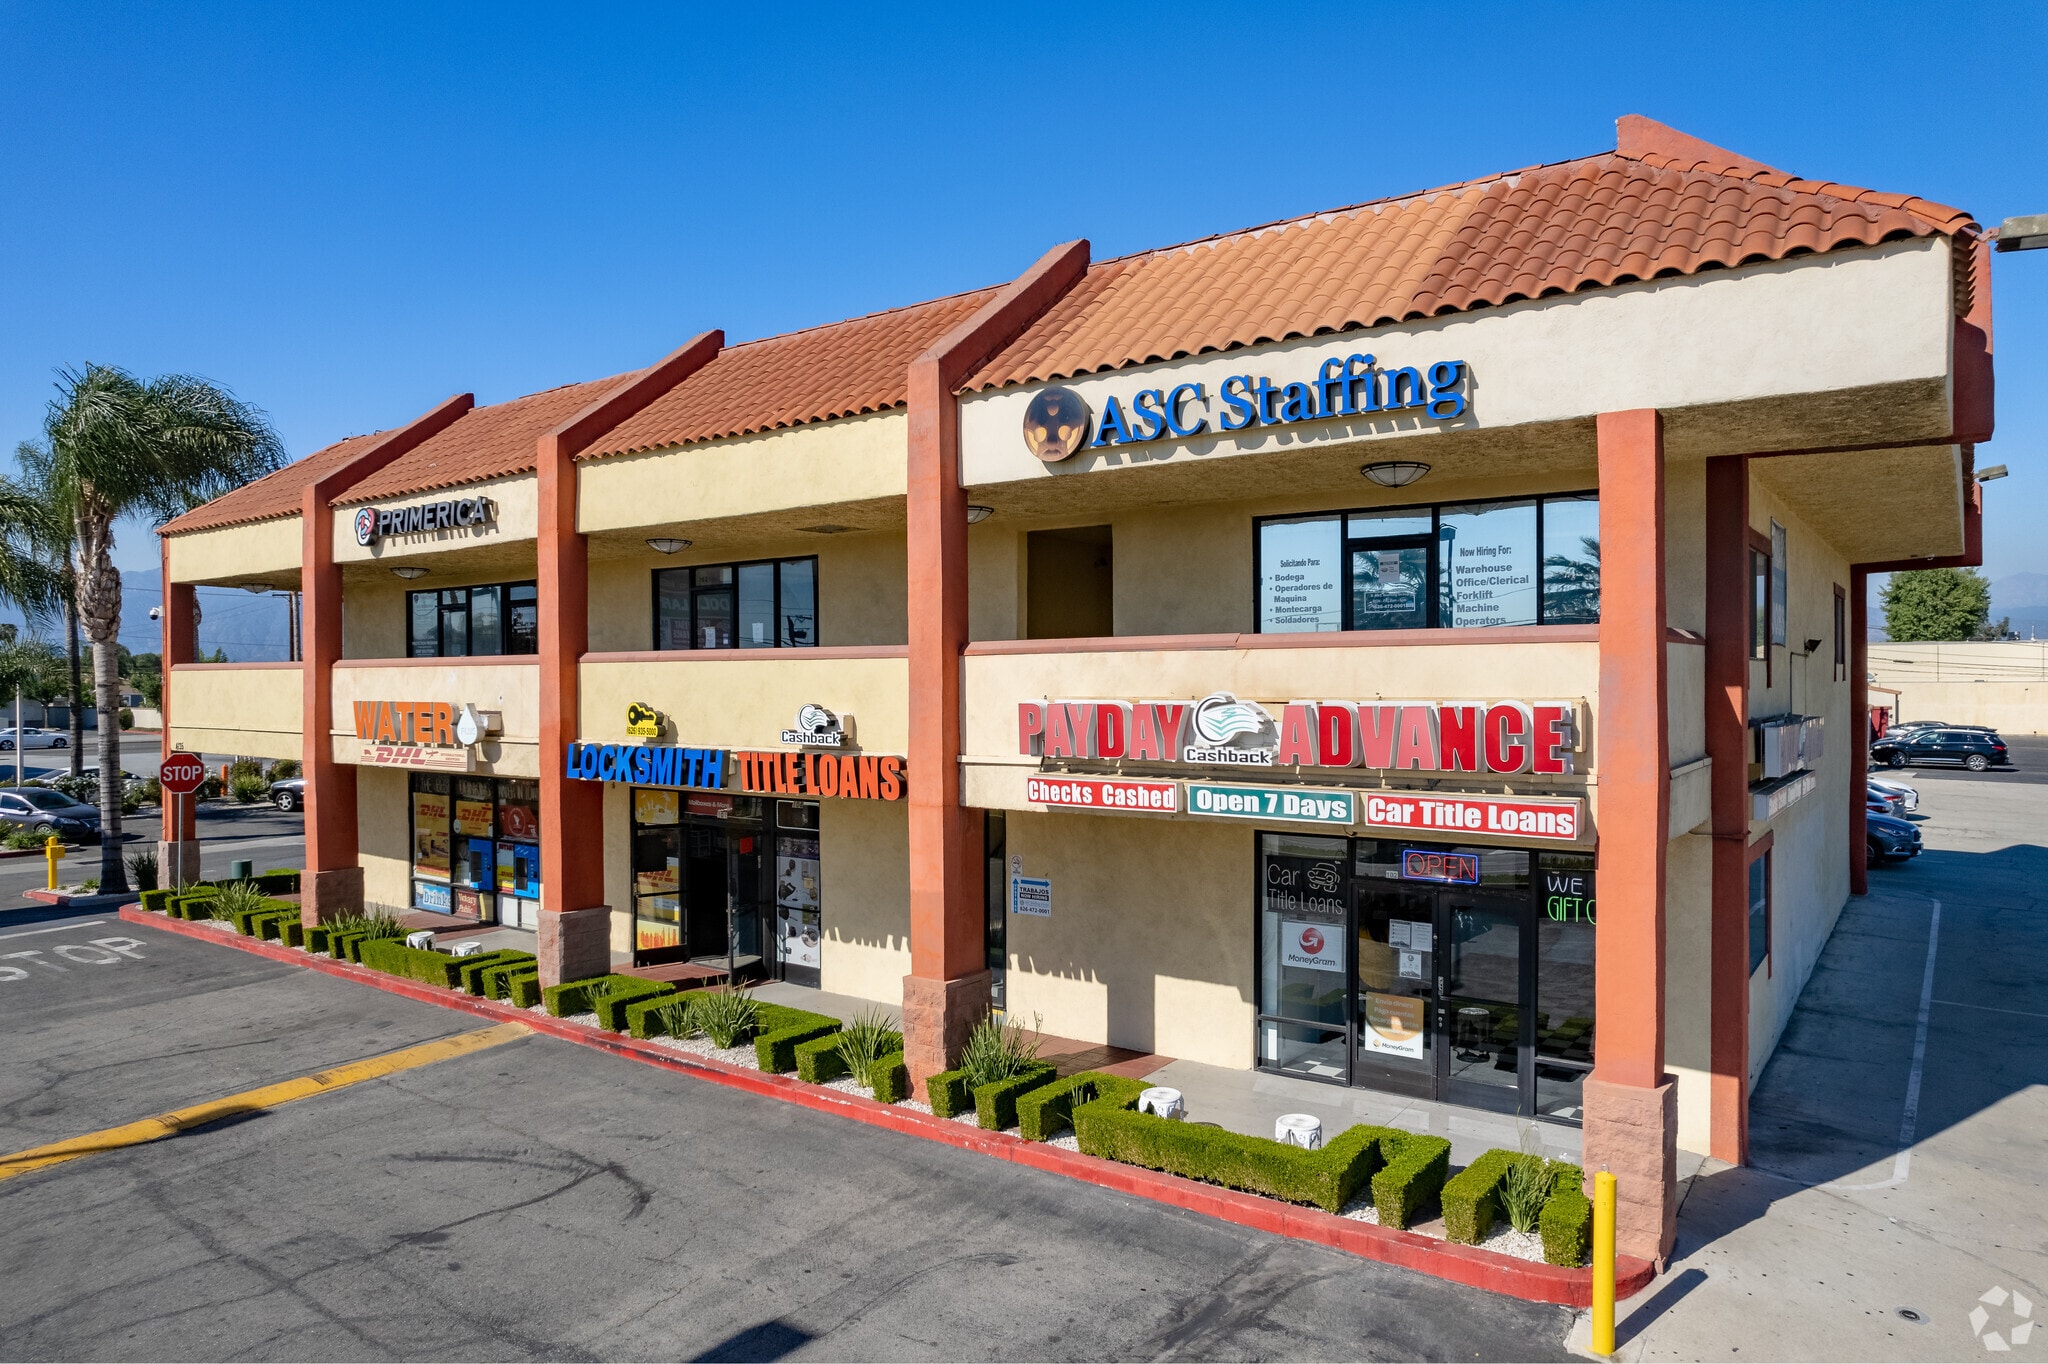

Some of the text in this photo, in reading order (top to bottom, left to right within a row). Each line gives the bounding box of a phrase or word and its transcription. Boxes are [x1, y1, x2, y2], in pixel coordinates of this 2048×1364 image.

[1091, 353, 1464, 447] ASC Staffing
[379, 496, 486, 536] PRIMERICA
[1460, 545, 1512, 557] Now Hiring For:
[1280, 558, 1307, 568] Solicitando
[1456, 564, 1513, 574] Warehouse
[1275, 574, 1305, 582] Bodega
[1456, 575, 1529, 587] Office/Clerical
[1275, 582, 1333, 593] Operadores de
[1274, 595, 1307, 604] Maquina
[1456, 590, 1493, 600] Forklift
[1275, 605, 1322, 614] Montecarga
[1456, 603, 1500, 613] Machine
[1275, 615, 1320, 624] Soldadores
[1455, 616, 1506, 627] Operators
[353, 700, 454, 745] WATER
[781, 731, 840, 745] Cashback
[1018, 703, 1566, 774] PAYDAY ADVANCE
[375, 746, 427, 765] DHL
[1186, 749, 1270, 765] Cashback
[567, 743, 724, 789] LOCKSMITH
[163, 766, 202, 782] STOP
[737, 751, 901, 801] TITLE LOANS
[1028, 780, 1175, 809] Checks Cashed
[1196, 788, 1347, 818] Open 7 Days
[420, 804, 447, 818] DHL
[460, 808, 491, 823] DHL
[1368, 800, 1574, 835] Car Title Loans
[1407, 853, 1475, 880] OPEN
[1267, 864, 1300, 886] Car
[1386, 871, 1398, 879] 102
[1020, 886, 1049, 895] TRABAJOS
[1547, 876, 1583, 895] WE
[423, 889, 450, 908] Drinks
[458, 892, 476, 906] Notary
[1268, 888, 1343, 915] Title Loans
[459, 904, 474, 914] Public
[1547, 896, 1582, 923] GIFT
[1288, 954, 1336, 967] MoneyGram
[1382, 1042, 1414, 1053] MoneyGram
